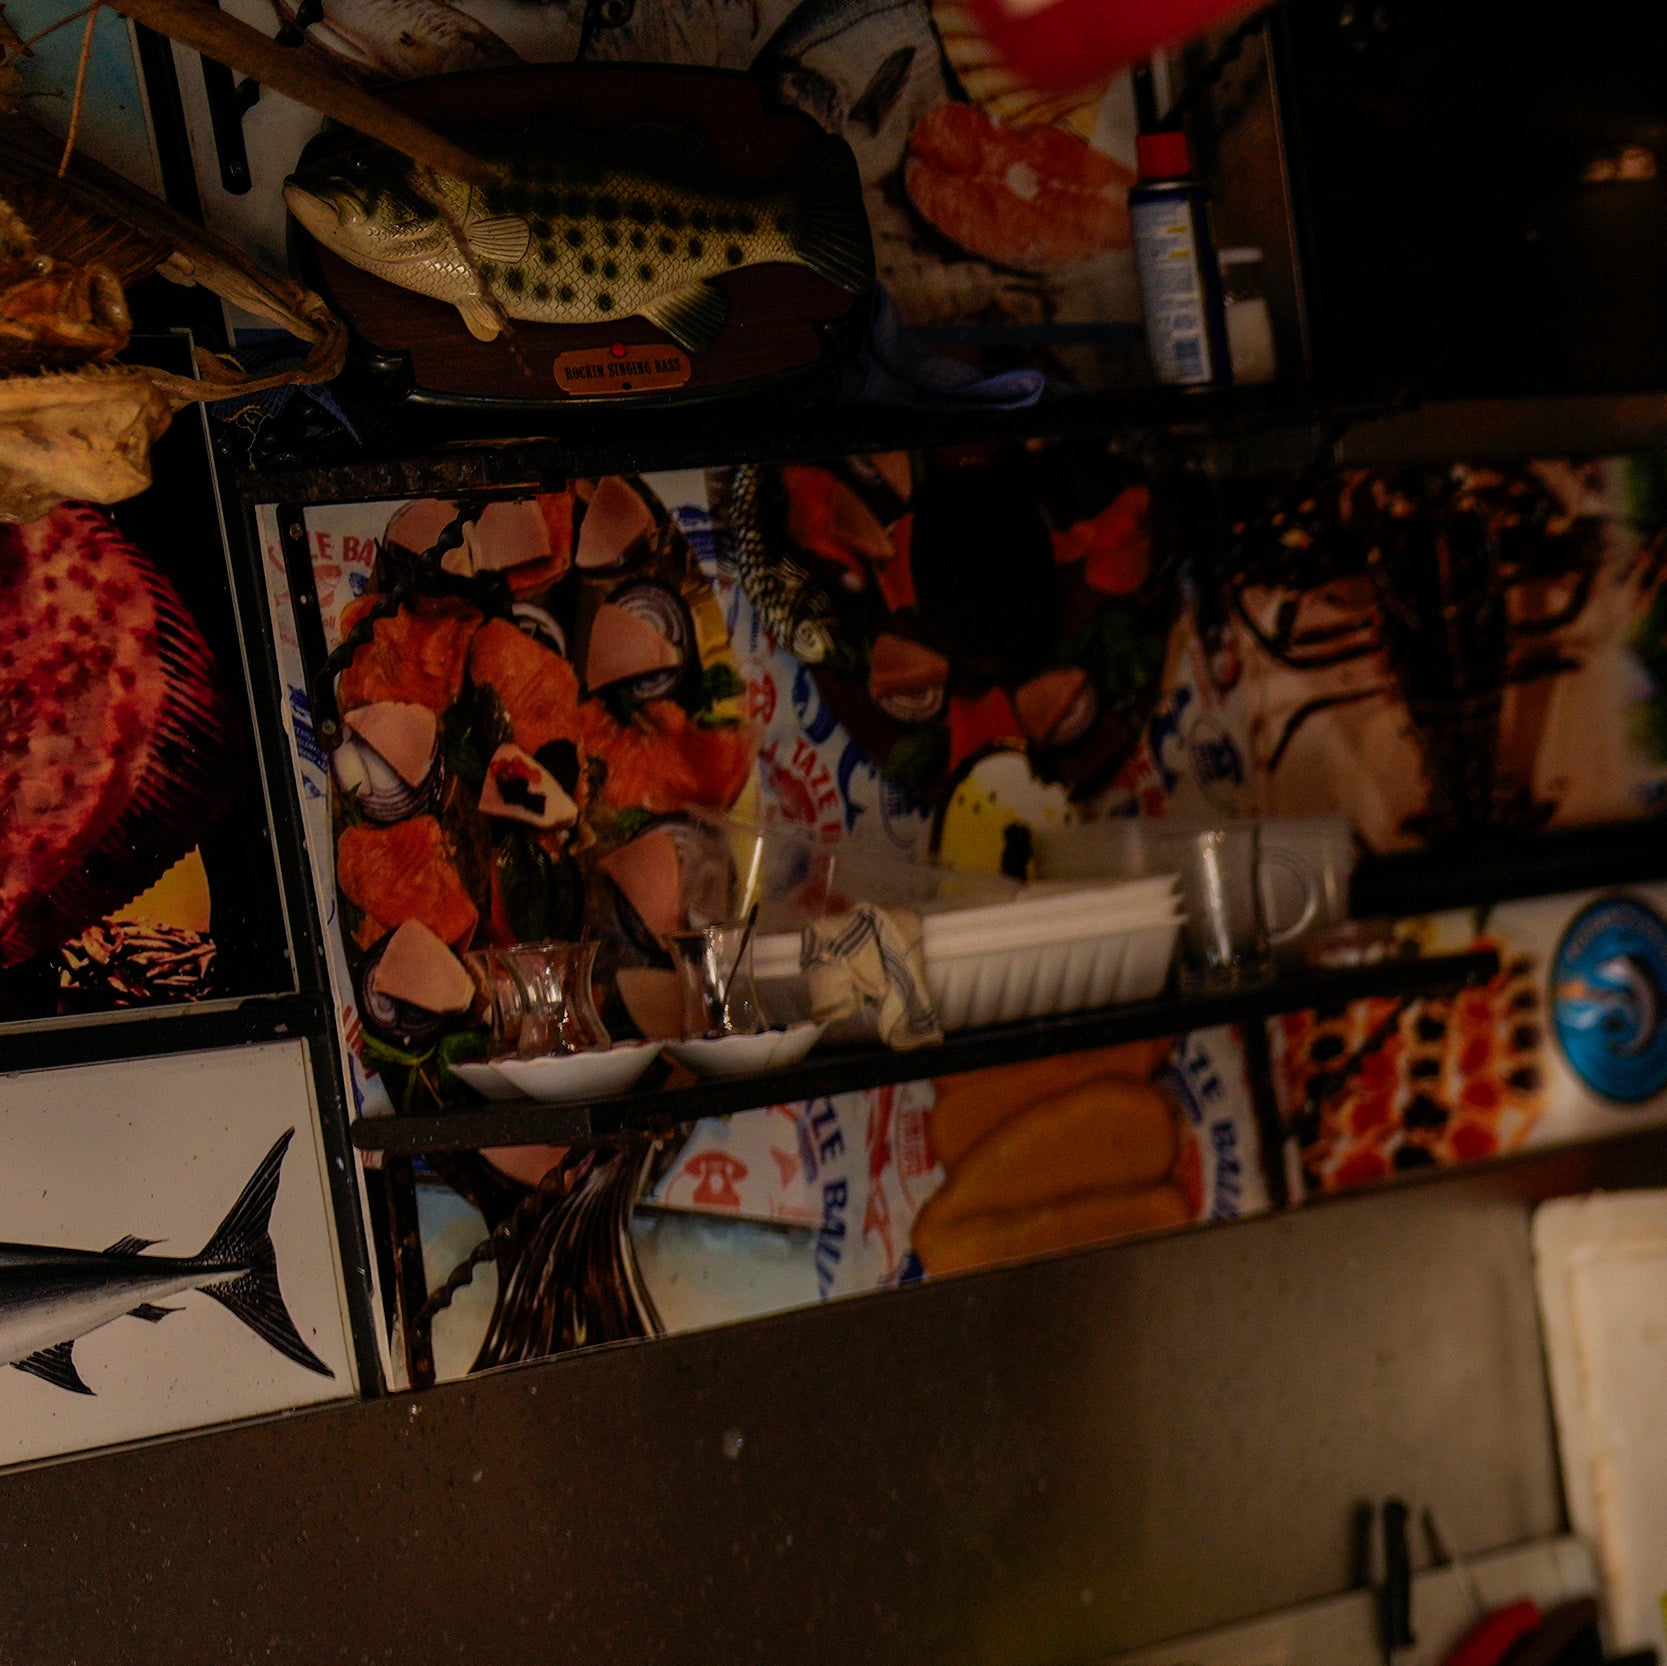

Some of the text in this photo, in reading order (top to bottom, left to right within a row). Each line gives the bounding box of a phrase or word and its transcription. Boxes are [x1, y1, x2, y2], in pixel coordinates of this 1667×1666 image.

[564, 358, 682, 380] ROCKIN SINGING BASS
